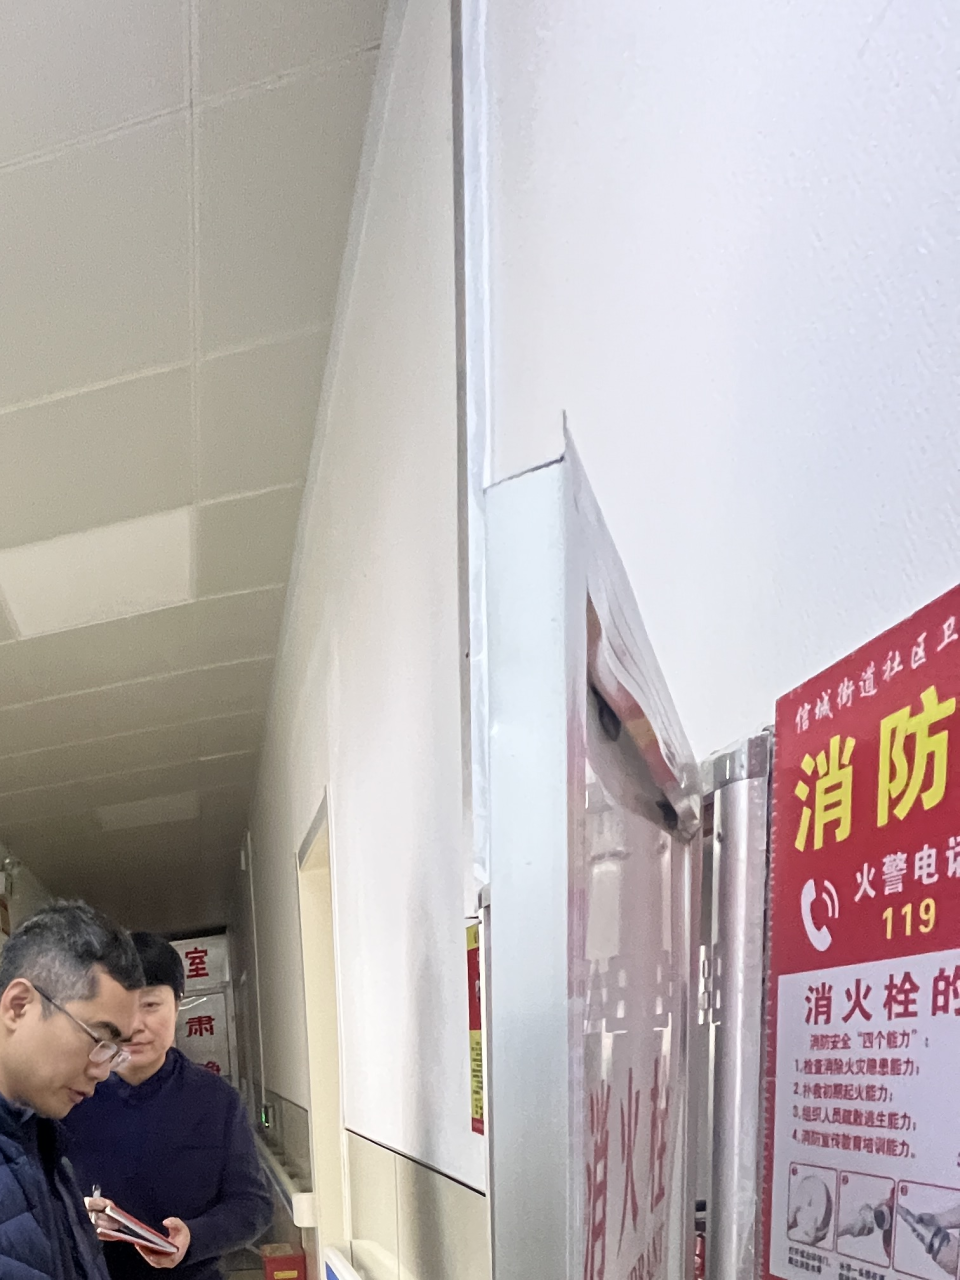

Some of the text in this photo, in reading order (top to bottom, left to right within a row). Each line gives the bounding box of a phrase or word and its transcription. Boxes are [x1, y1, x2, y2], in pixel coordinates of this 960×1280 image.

[794, 685, 956, 852] 消防
[882, 898, 936, 940] 119
[185, 947, 209, 979] 室
[804, 965, 960, 1026] 消火栓的
